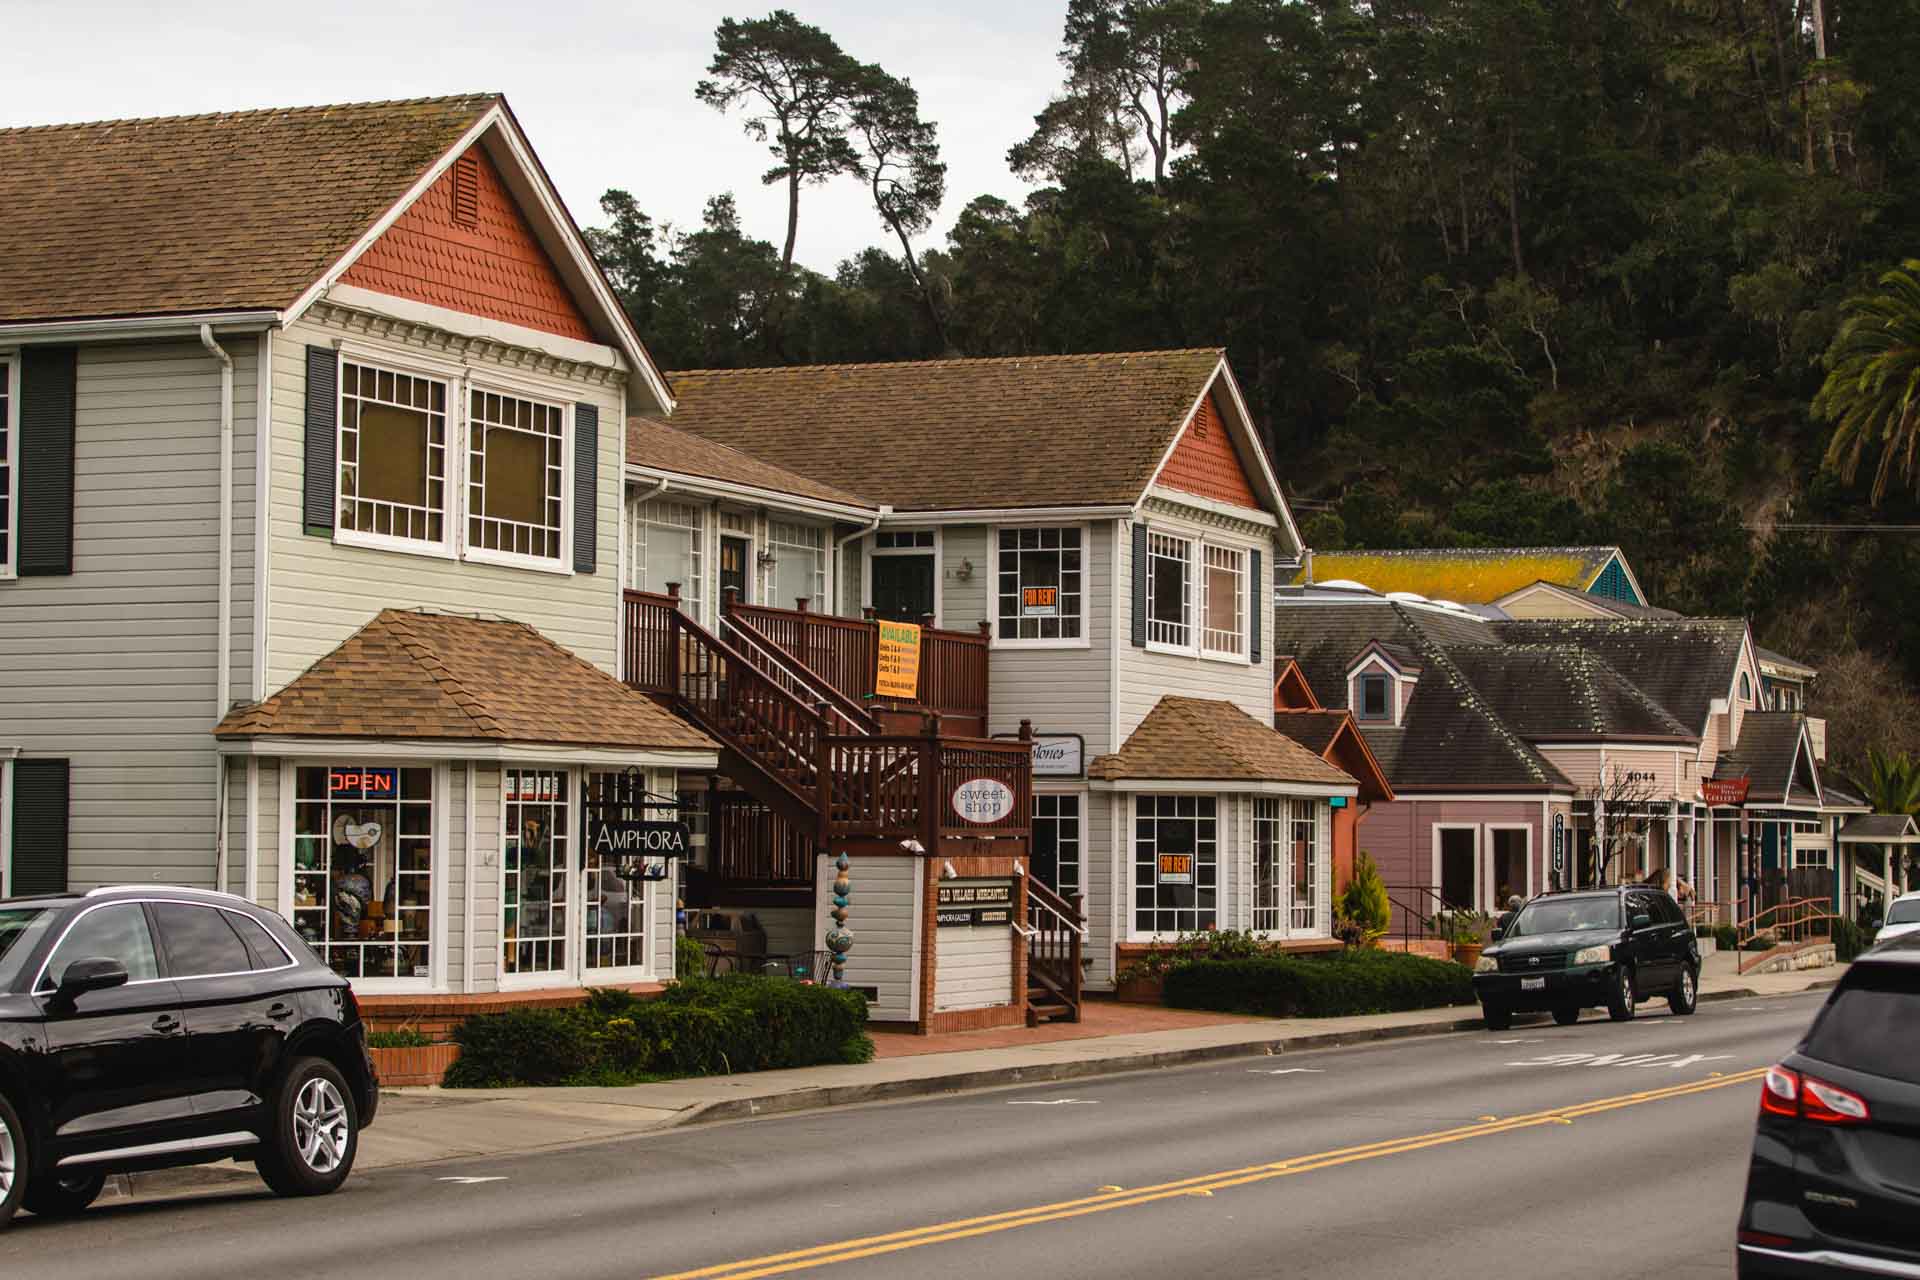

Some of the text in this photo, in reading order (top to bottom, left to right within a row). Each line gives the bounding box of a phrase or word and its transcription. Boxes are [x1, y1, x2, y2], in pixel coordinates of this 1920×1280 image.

[1024, 589, 1056, 606] FOR RENT
[881, 624, 919, 645] AVAILABLE
[329, 774, 391, 790] OPEN
[960, 789, 1006, 800] sweet
[965, 800, 1001, 815] shop
[594, 823, 684, 851] AMPHORA
[1160, 856, 1190, 873] FOR RENT
[940, 887, 1009, 902] OLD VILLAGE MERCANTILE
